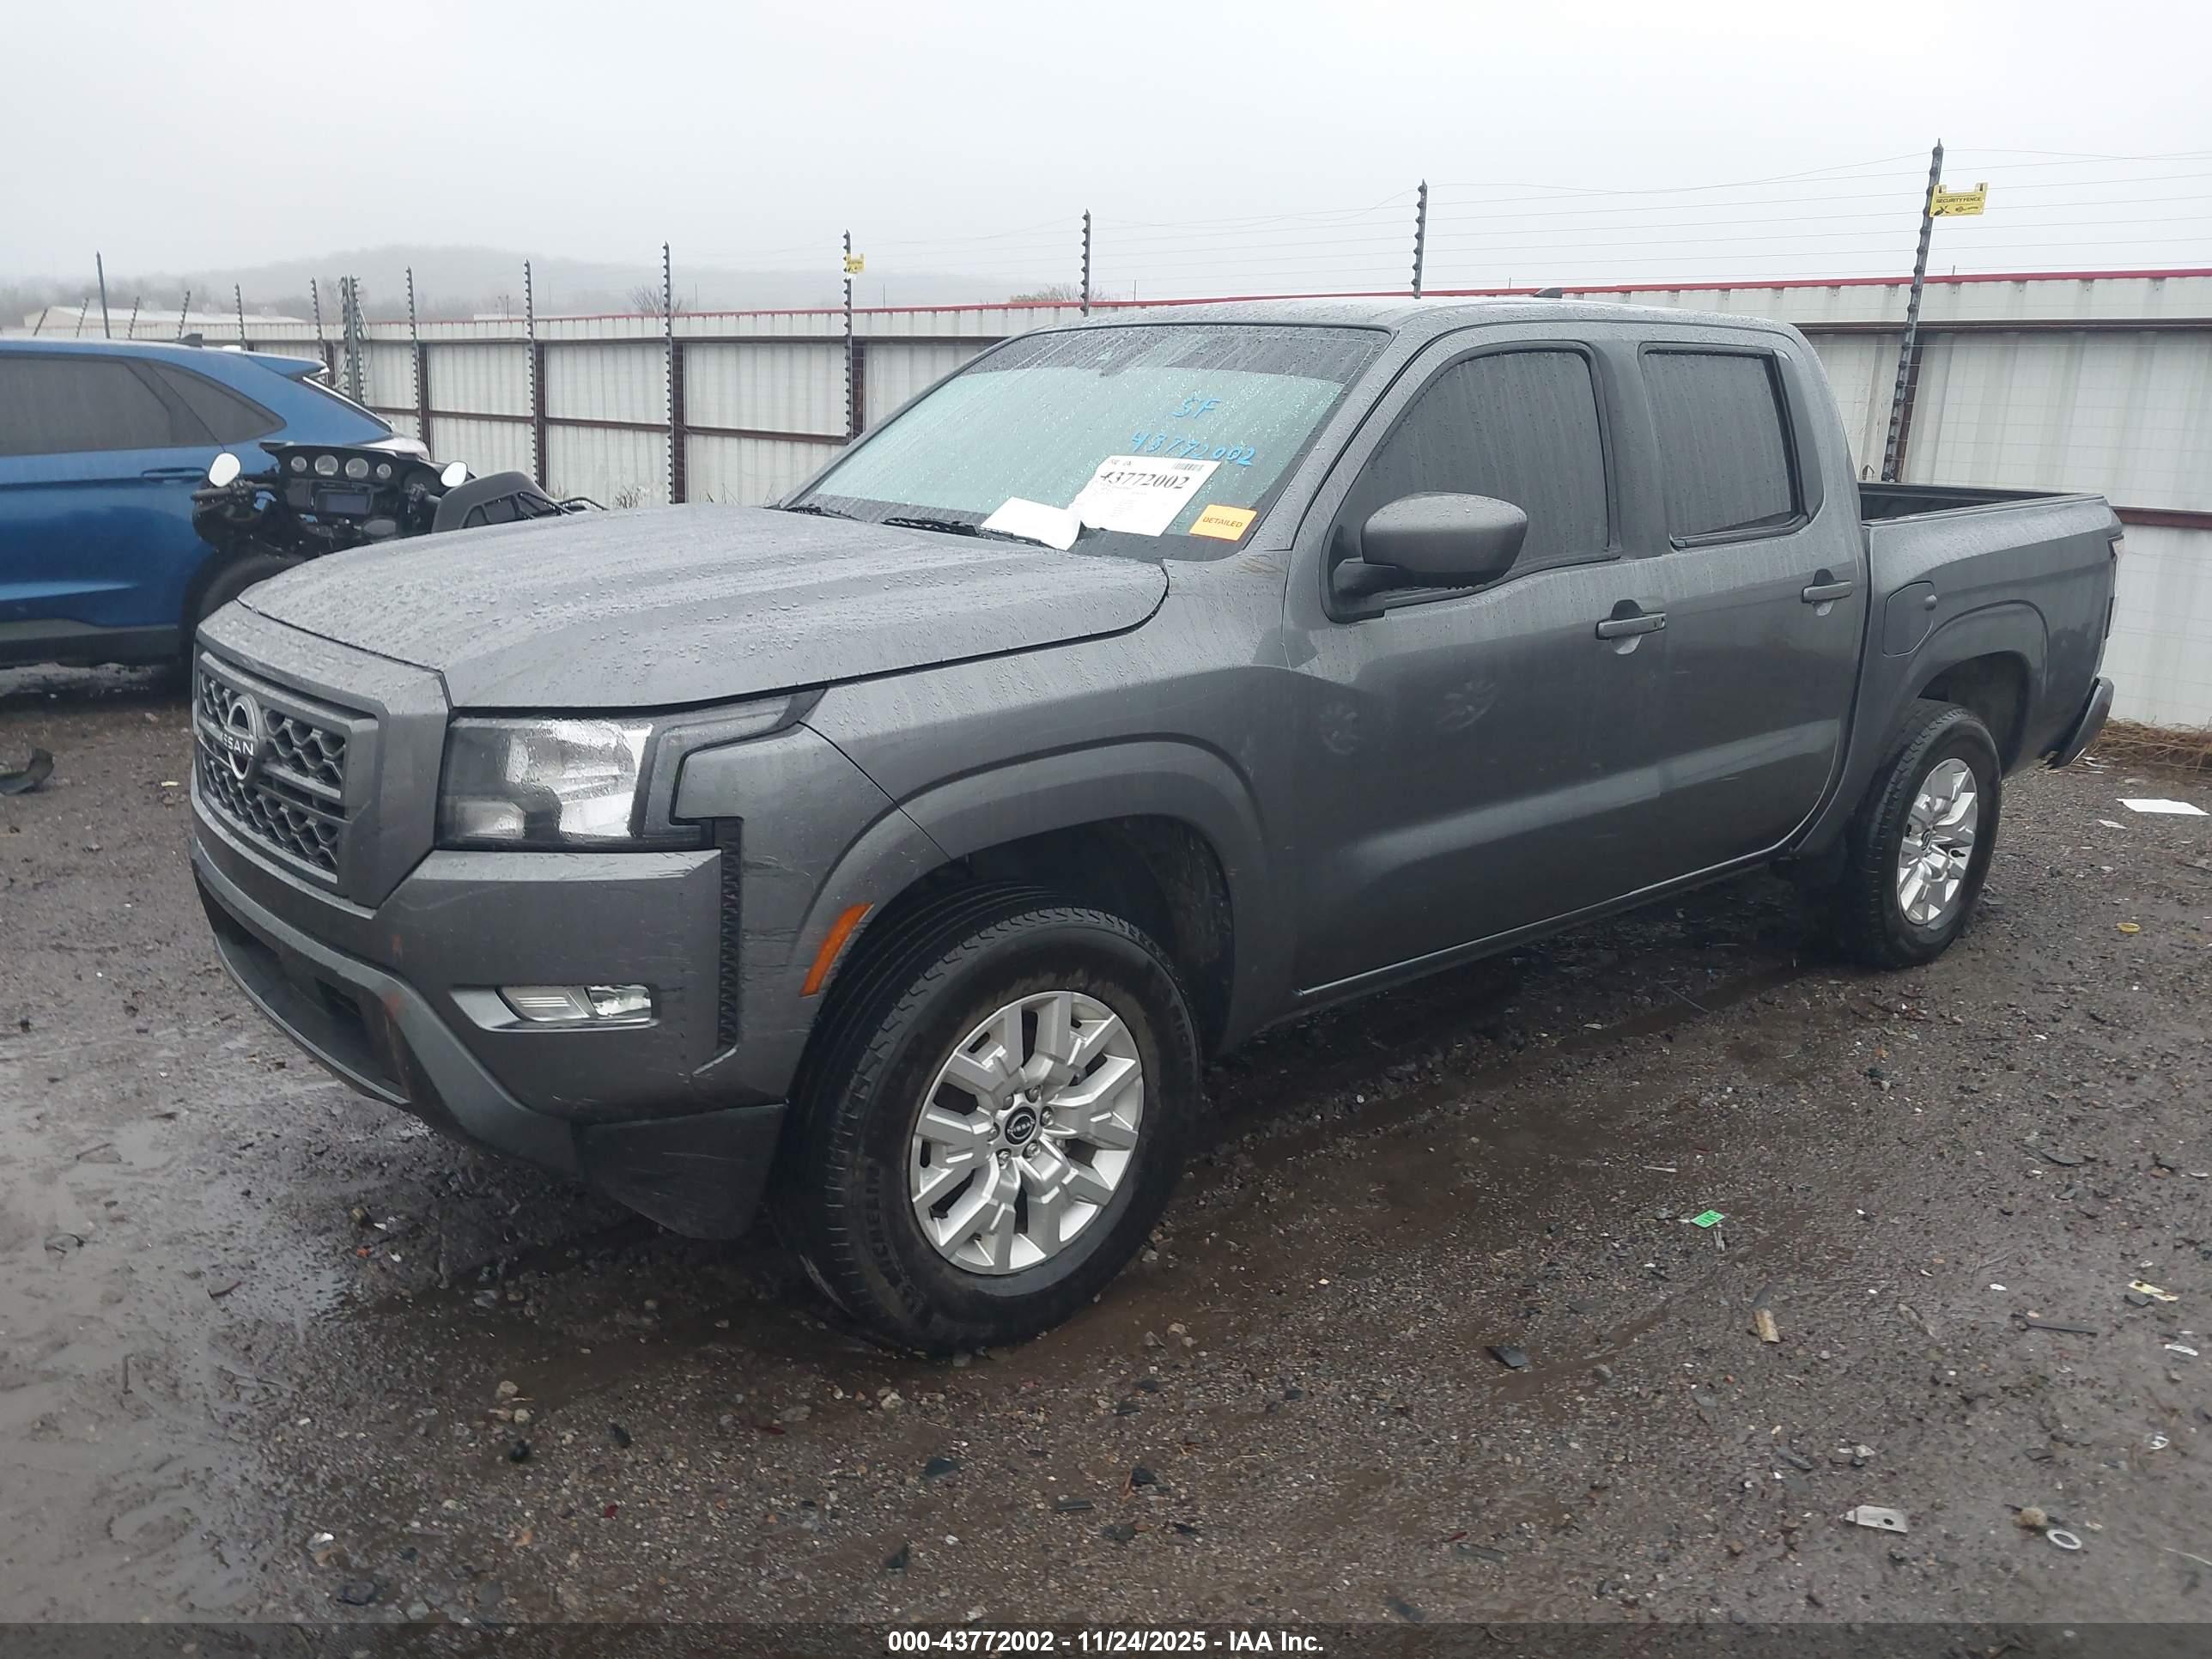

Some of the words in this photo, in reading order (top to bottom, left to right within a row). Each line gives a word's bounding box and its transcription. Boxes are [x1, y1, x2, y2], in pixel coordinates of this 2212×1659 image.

[1132, 431, 1257, 466] 43772002
[1100, 471, 1191, 489] 43772002
[1203, 516, 1243, 528] DETAILED
